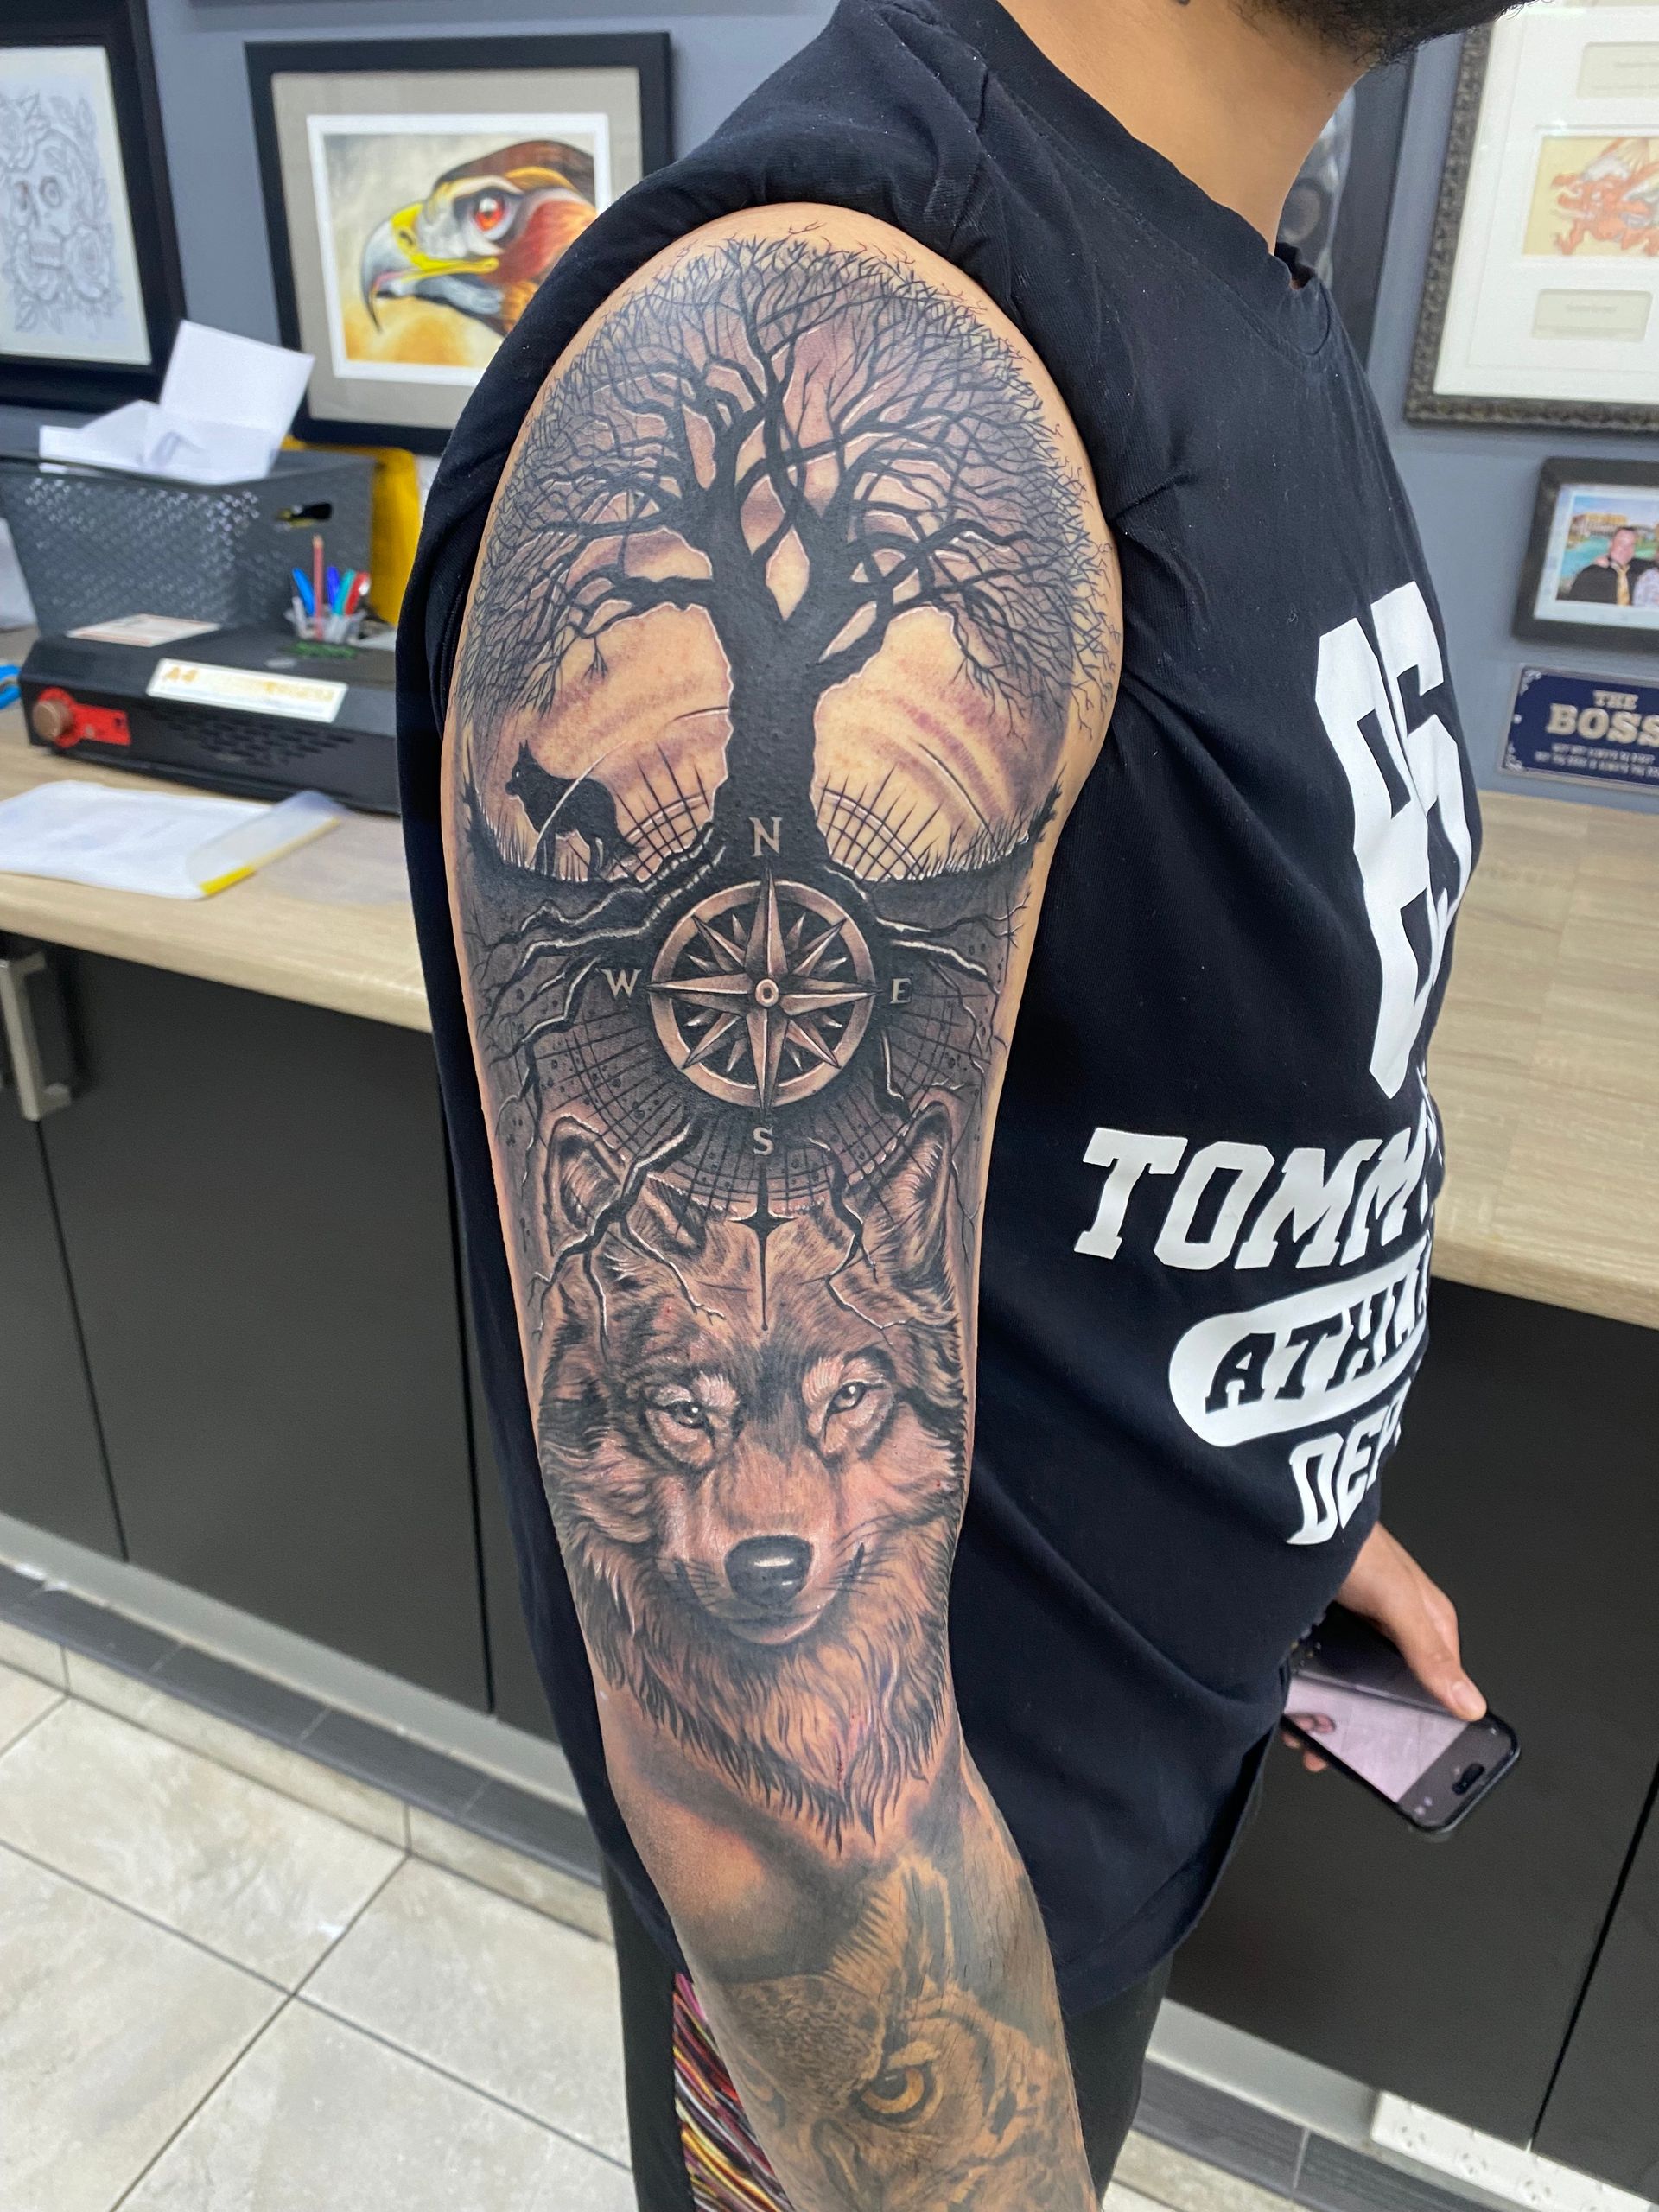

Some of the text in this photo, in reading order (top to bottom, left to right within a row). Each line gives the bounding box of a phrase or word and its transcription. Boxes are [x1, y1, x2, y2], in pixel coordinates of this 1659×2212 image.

[1593, 690, 1639, 710] THE
[1547, 702, 1659, 747] BOSS
[749, 816, 783, 857] N
[600, 969, 642, 998] W
[890, 977, 912, 1005] E
[753, 1125, 774, 1156] S
